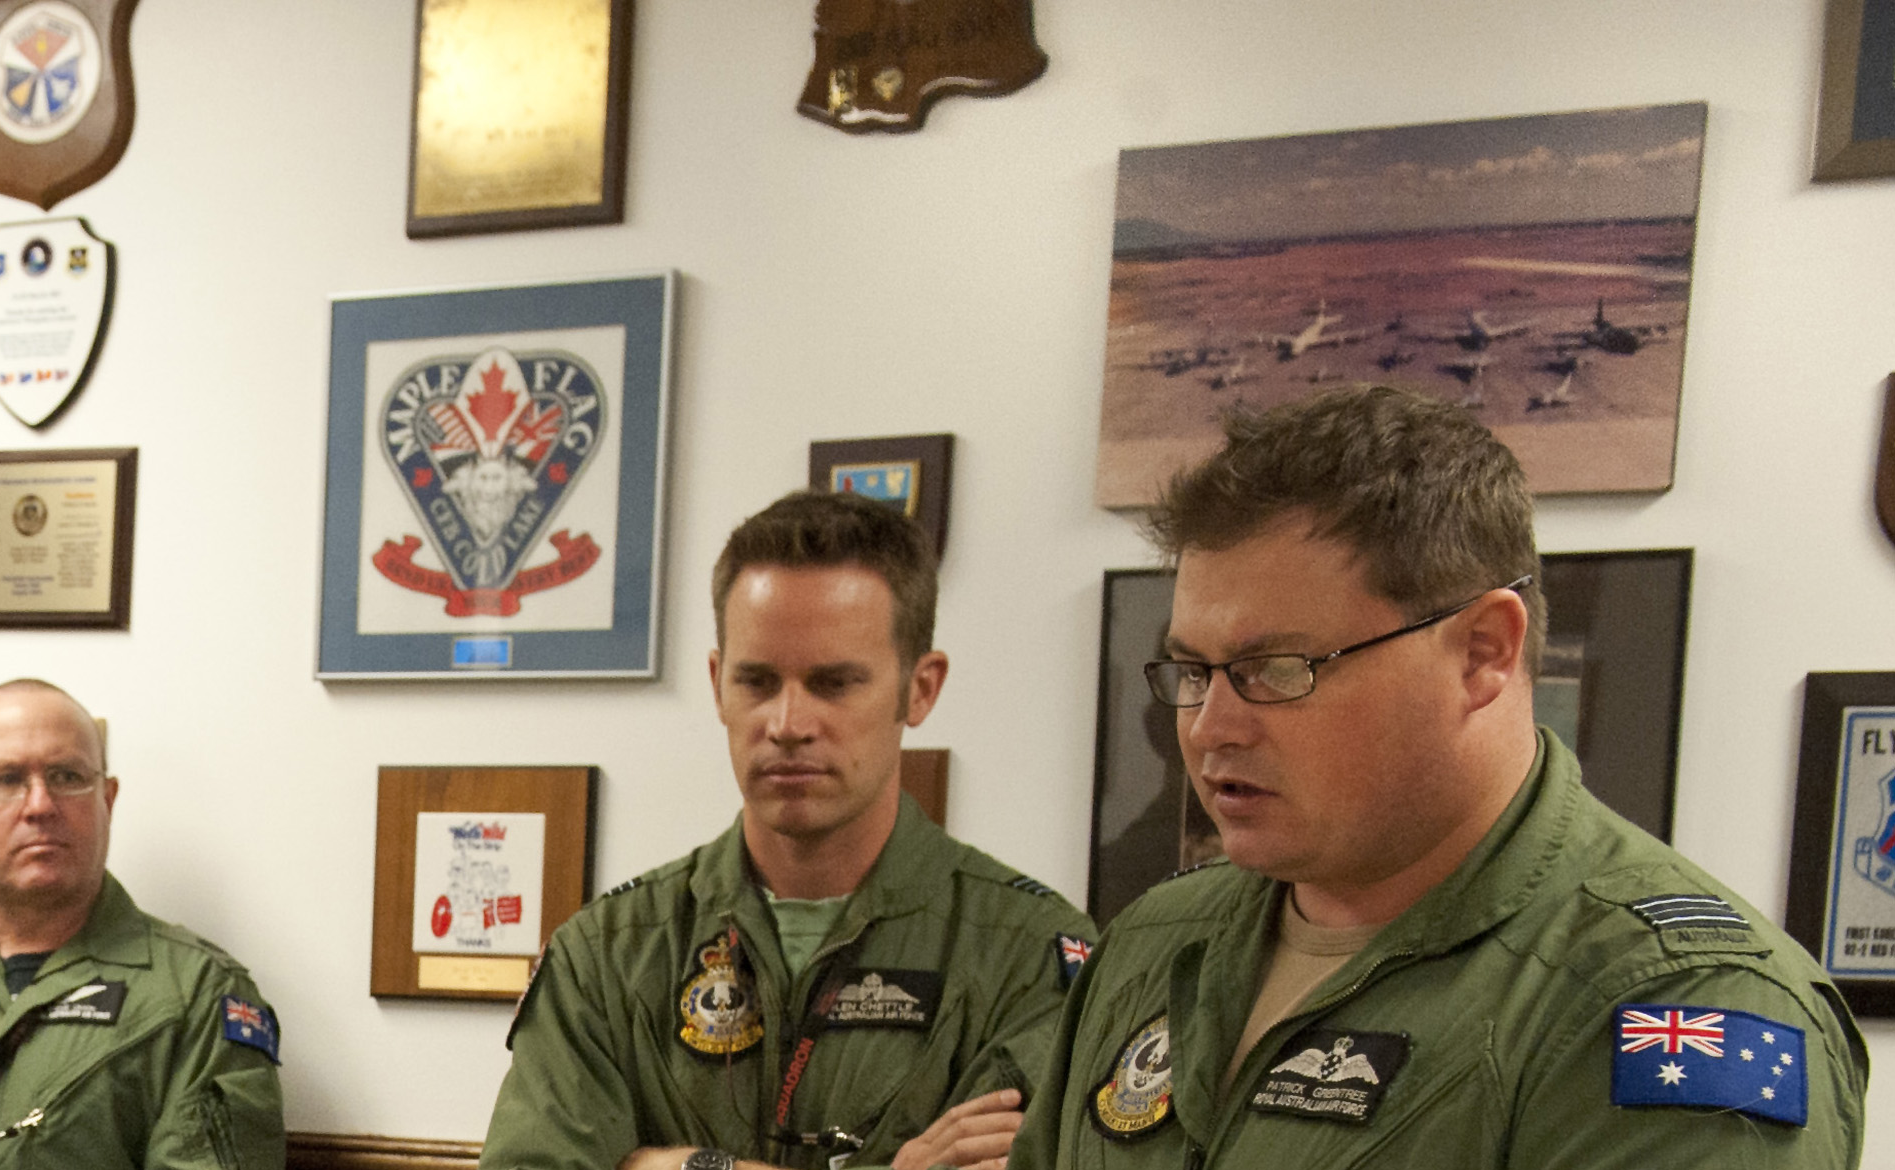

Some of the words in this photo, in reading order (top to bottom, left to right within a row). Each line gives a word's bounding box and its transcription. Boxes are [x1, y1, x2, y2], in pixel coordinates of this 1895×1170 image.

[389, 364, 462, 464] MAPLE
[533, 360, 598, 456] FLAG
[453, 537, 506, 587] COLD
[504, 500, 547, 551] LAKE
[1265, 1080, 1307, 1095] PATRICK
